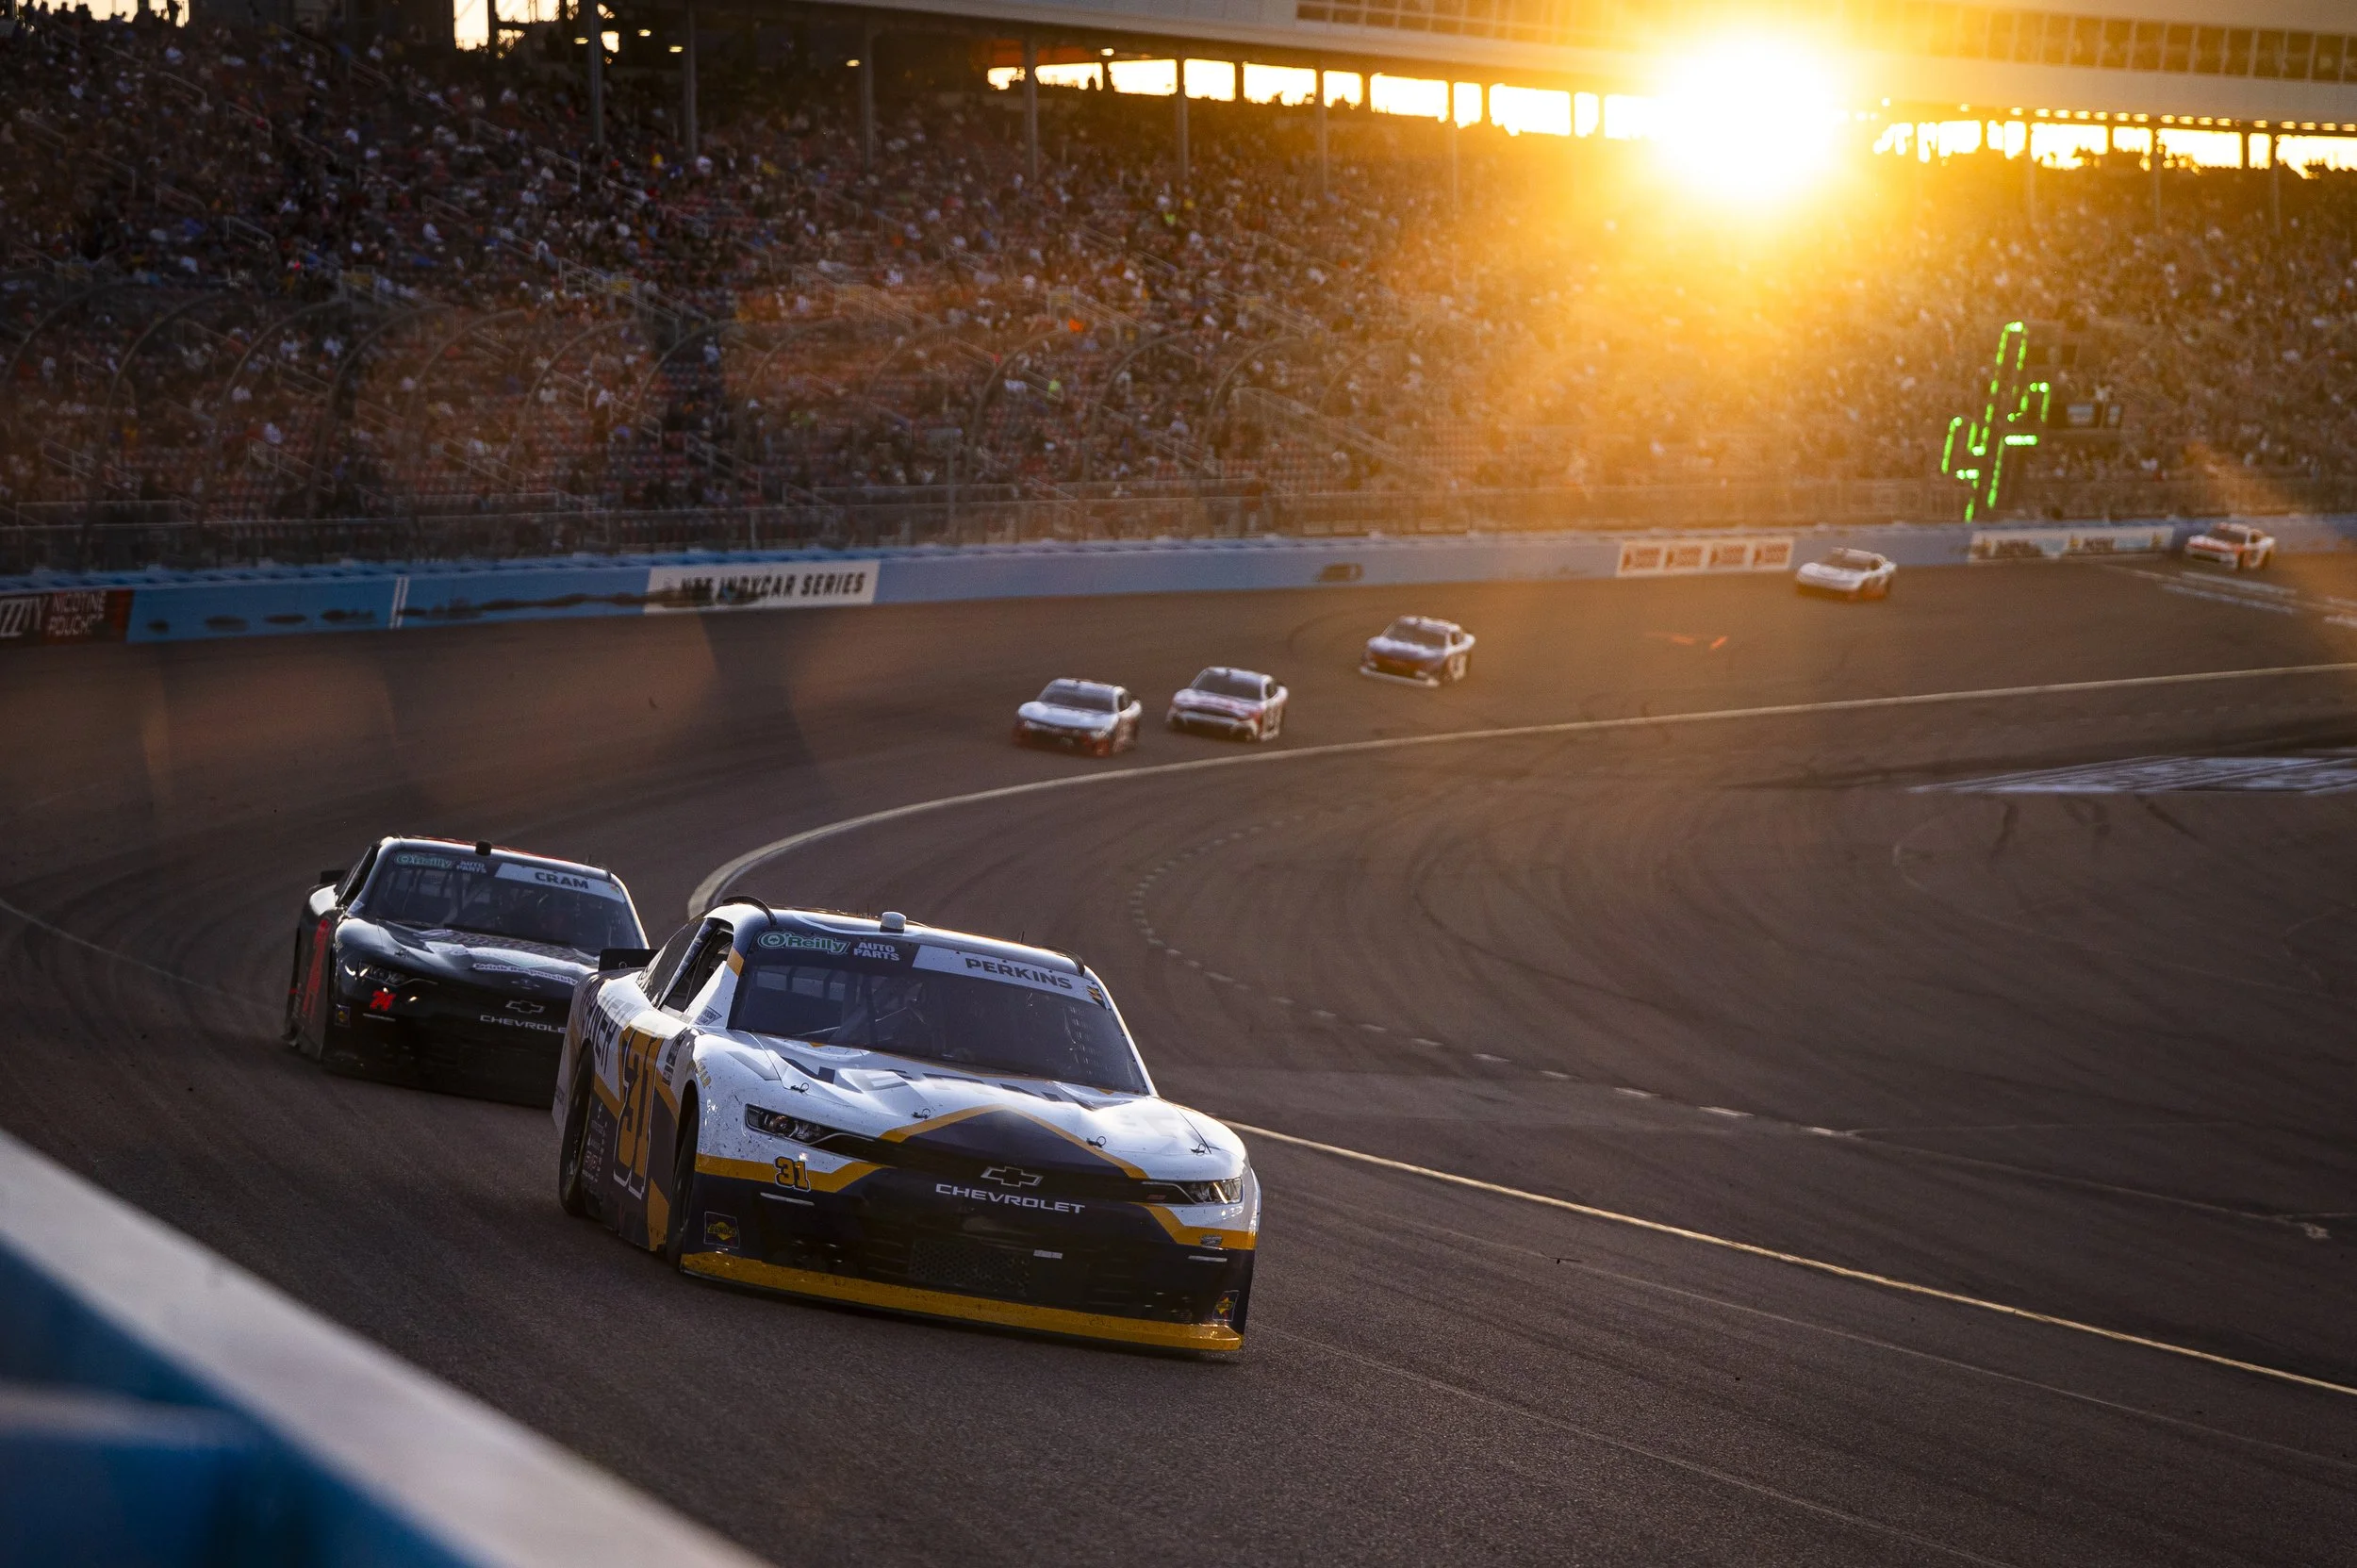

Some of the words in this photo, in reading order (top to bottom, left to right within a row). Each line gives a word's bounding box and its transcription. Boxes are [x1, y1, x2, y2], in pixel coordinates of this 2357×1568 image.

[717, 573, 797, 601] INDYCAR
[800, 571, 866, 596] SERIES
[52, 590, 107, 613] NICOTINE
[456, 865, 486, 874] PARTS
[460, 860, 485, 868] AUTO
[535, 871, 589, 890] CRAM
[757, 930, 850, 955] O'Reilly
[857, 941, 897, 954] AUTO
[853, 948, 900, 963] PARTS
[472, 962, 507, 974] Drink
[510, 966, 579, 985] Responsibly
[964, 957, 1073, 990] PERKINS
[479, 1014, 567, 1034] CHEVROLE
[614, 1024, 665, 1200] 31
[774, 1156, 811, 1193] 31
[935, 1182, 1085, 1214] CHEVROLET
[707, 1223, 737, 1238] SUNOCO
